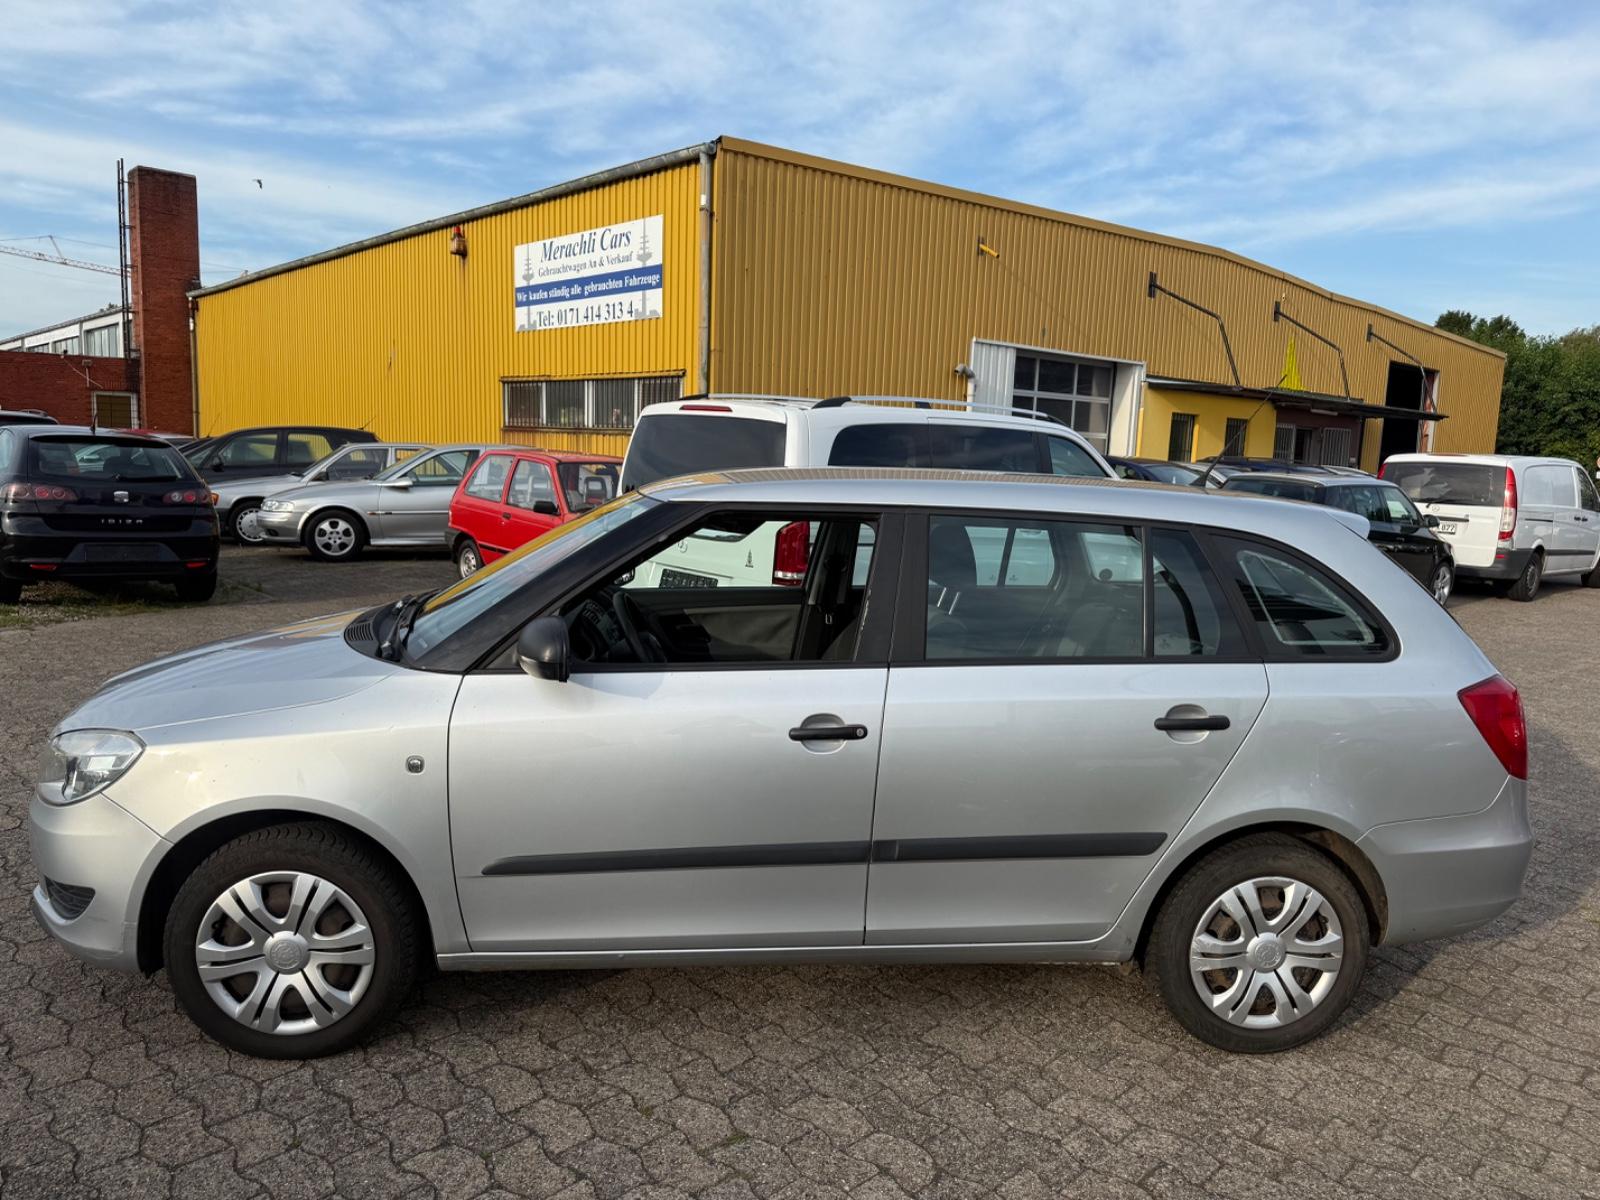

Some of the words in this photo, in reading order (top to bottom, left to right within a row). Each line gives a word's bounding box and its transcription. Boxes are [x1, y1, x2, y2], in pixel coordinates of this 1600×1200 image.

[540, 231, 597, 262] Merachli
[600, 228, 632, 251] Cars
[538, 261, 587, 278] Gebrauchtwagen
[588, 261, 597, 270] An
[599, 257, 605, 268] &
[606, 251, 634, 266] Verkauf
[516, 292, 527, 302] Wir
[528, 289, 549, 300] kaufen
[549, 285, 570, 298] ständig
[570, 284, 582, 295] alle
[584, 279, 623, 296] gebrauchten
[624, 273, 660, 287] Fahrzeuge
[537, 310, 555, 327] Tel:
[557, 307, 579, 325] 0171
[583, 304, 602, 322] 414
[604, 301, 624, 320] 313
[627, 299, 634, 318] 4
